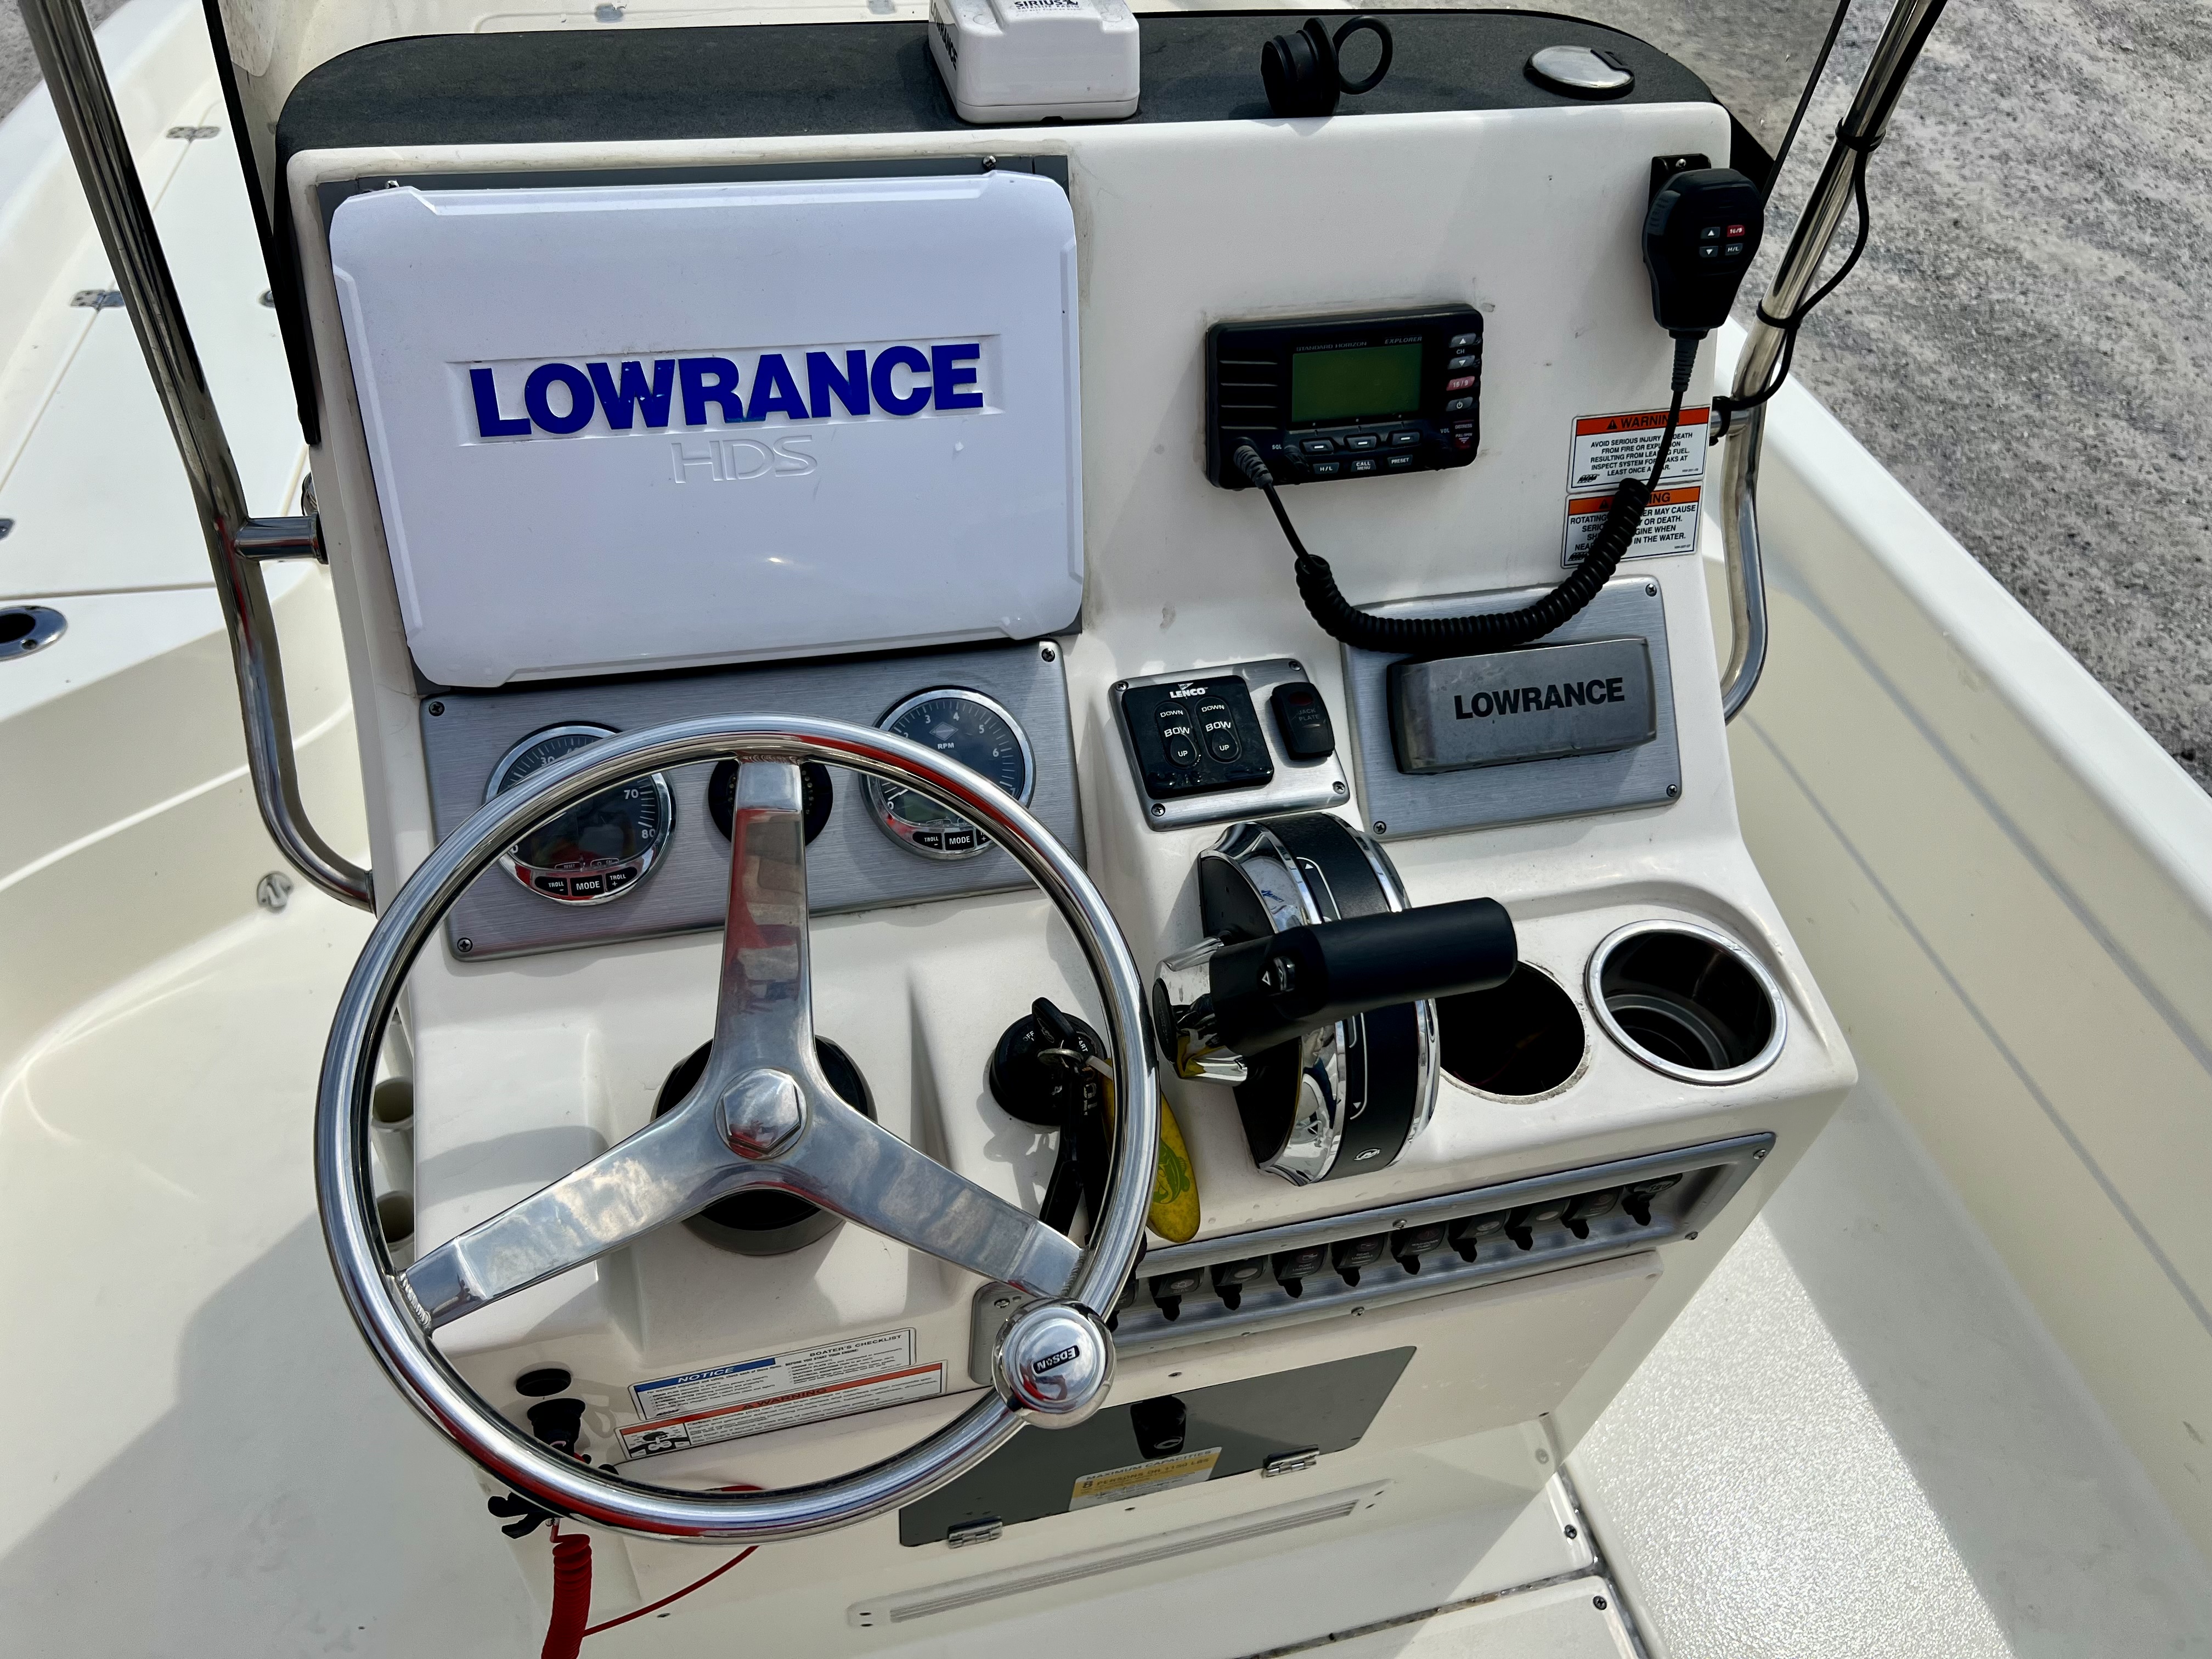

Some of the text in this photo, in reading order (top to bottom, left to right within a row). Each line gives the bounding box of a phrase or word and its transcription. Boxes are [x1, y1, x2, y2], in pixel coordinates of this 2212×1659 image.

[1384, 336, 1422, 345] EXPLORER
[469, 343, 983, 437] LOWRANCE
[1621, 414, 1679, 428] WARNIN
[1611, 437, 1638, 445] SERIOUS
[670, 435, 818, 484] HDS
[1591, 455, 1624, 463] RESULTING
[1607, 468, 1627, 476] LEAST
[1570, 514, 1607, 524] ROTATING
[1654, 507, 1670, 516] MAY
[1671, 505, 1696, 513] CAUSE
[1657, 516, 1683, 524] DEATH.
[1654, 525, 1676, 533] WHEN
[1658, 533, 1686, 541] WATER.
[1169, 687, 1206, 698] LENCO
[1454, 677, 1625, 720] LOWRANCE
[1201, 704, 1224, 713] DOWN
[925, 715, 931, 724] 3
[953, 712, 960, 721] 4
[979, 725, 985, 734] 5
[1164, 726, 1190, 737] BOW
[1205, 721, 1231, 732] BOW
[992, 748, 1000, 757] 6
[624, 789, 639, 800] 70
[641, 828, 656, 839] 80
[949, 836, 970, 844] MODE
[576, 881, 601, 890] MODE
[1023, 1030, 1035, 1041] OFF
[1649, 1182, 1672, 1192] 12V
[810, 1335, 901, 1357] BOATER'S CHECKLIST
[1036, 1347, 1076, 1371] EDSON
[678, 1367, 735, 1383] NOTICE
[757, 1388, 827, 1406] WARNING
[1086, 1450, 1212, 1480] MAXIMUM CAPACITIES
